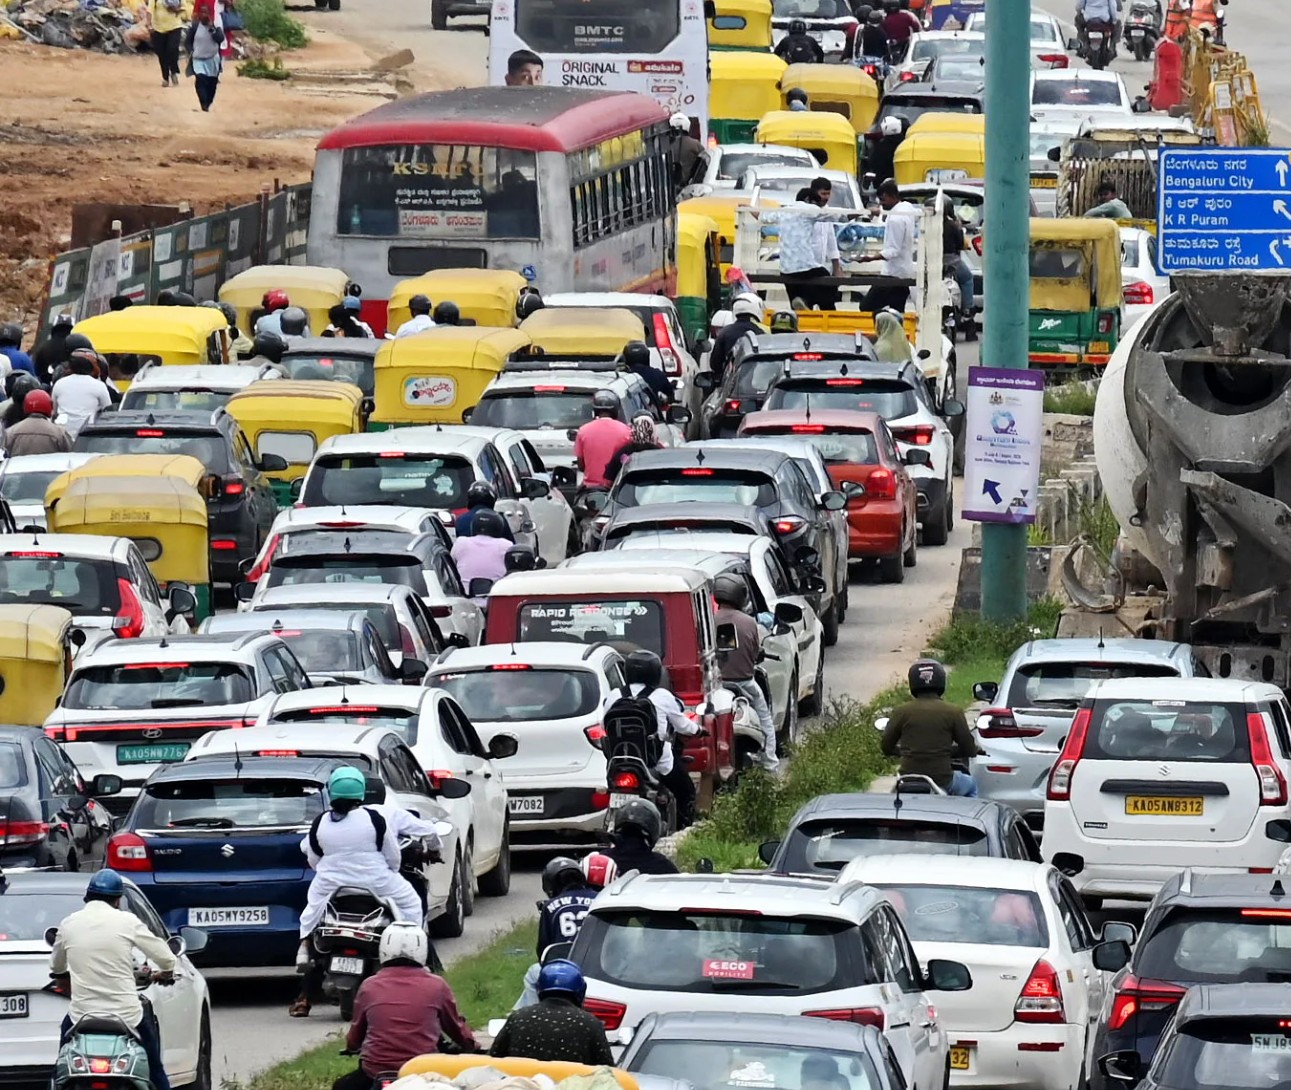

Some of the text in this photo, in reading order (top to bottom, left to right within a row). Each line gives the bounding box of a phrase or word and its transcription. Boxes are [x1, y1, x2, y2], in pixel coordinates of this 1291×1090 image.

[575, 26, 624, 36] BMTC
[562, 62, 620, 74] ORIGINAL
[1166, 159, 1248, 171] ಬೆಂಗಳೂರು ನಗರ
[1166, 176, 1254, 189] Bengaluru City
[1177, 198, 1199, 209] ಆರ್
[1205, 198, 1232, 210] ಪುರಂ
[1165, 215, 1229, 226] K R Puram
[1164, 238, 1242, 254] ತುಮಕೂರು ರಸ್ತೆ
[1164, 254, 1259, 266] Tumakuru Road
[531, 606, 632, 618] RAPID RESPONSE
[547, 897, 573, 914] NEW
[722, 962, 747, 971] ECO
